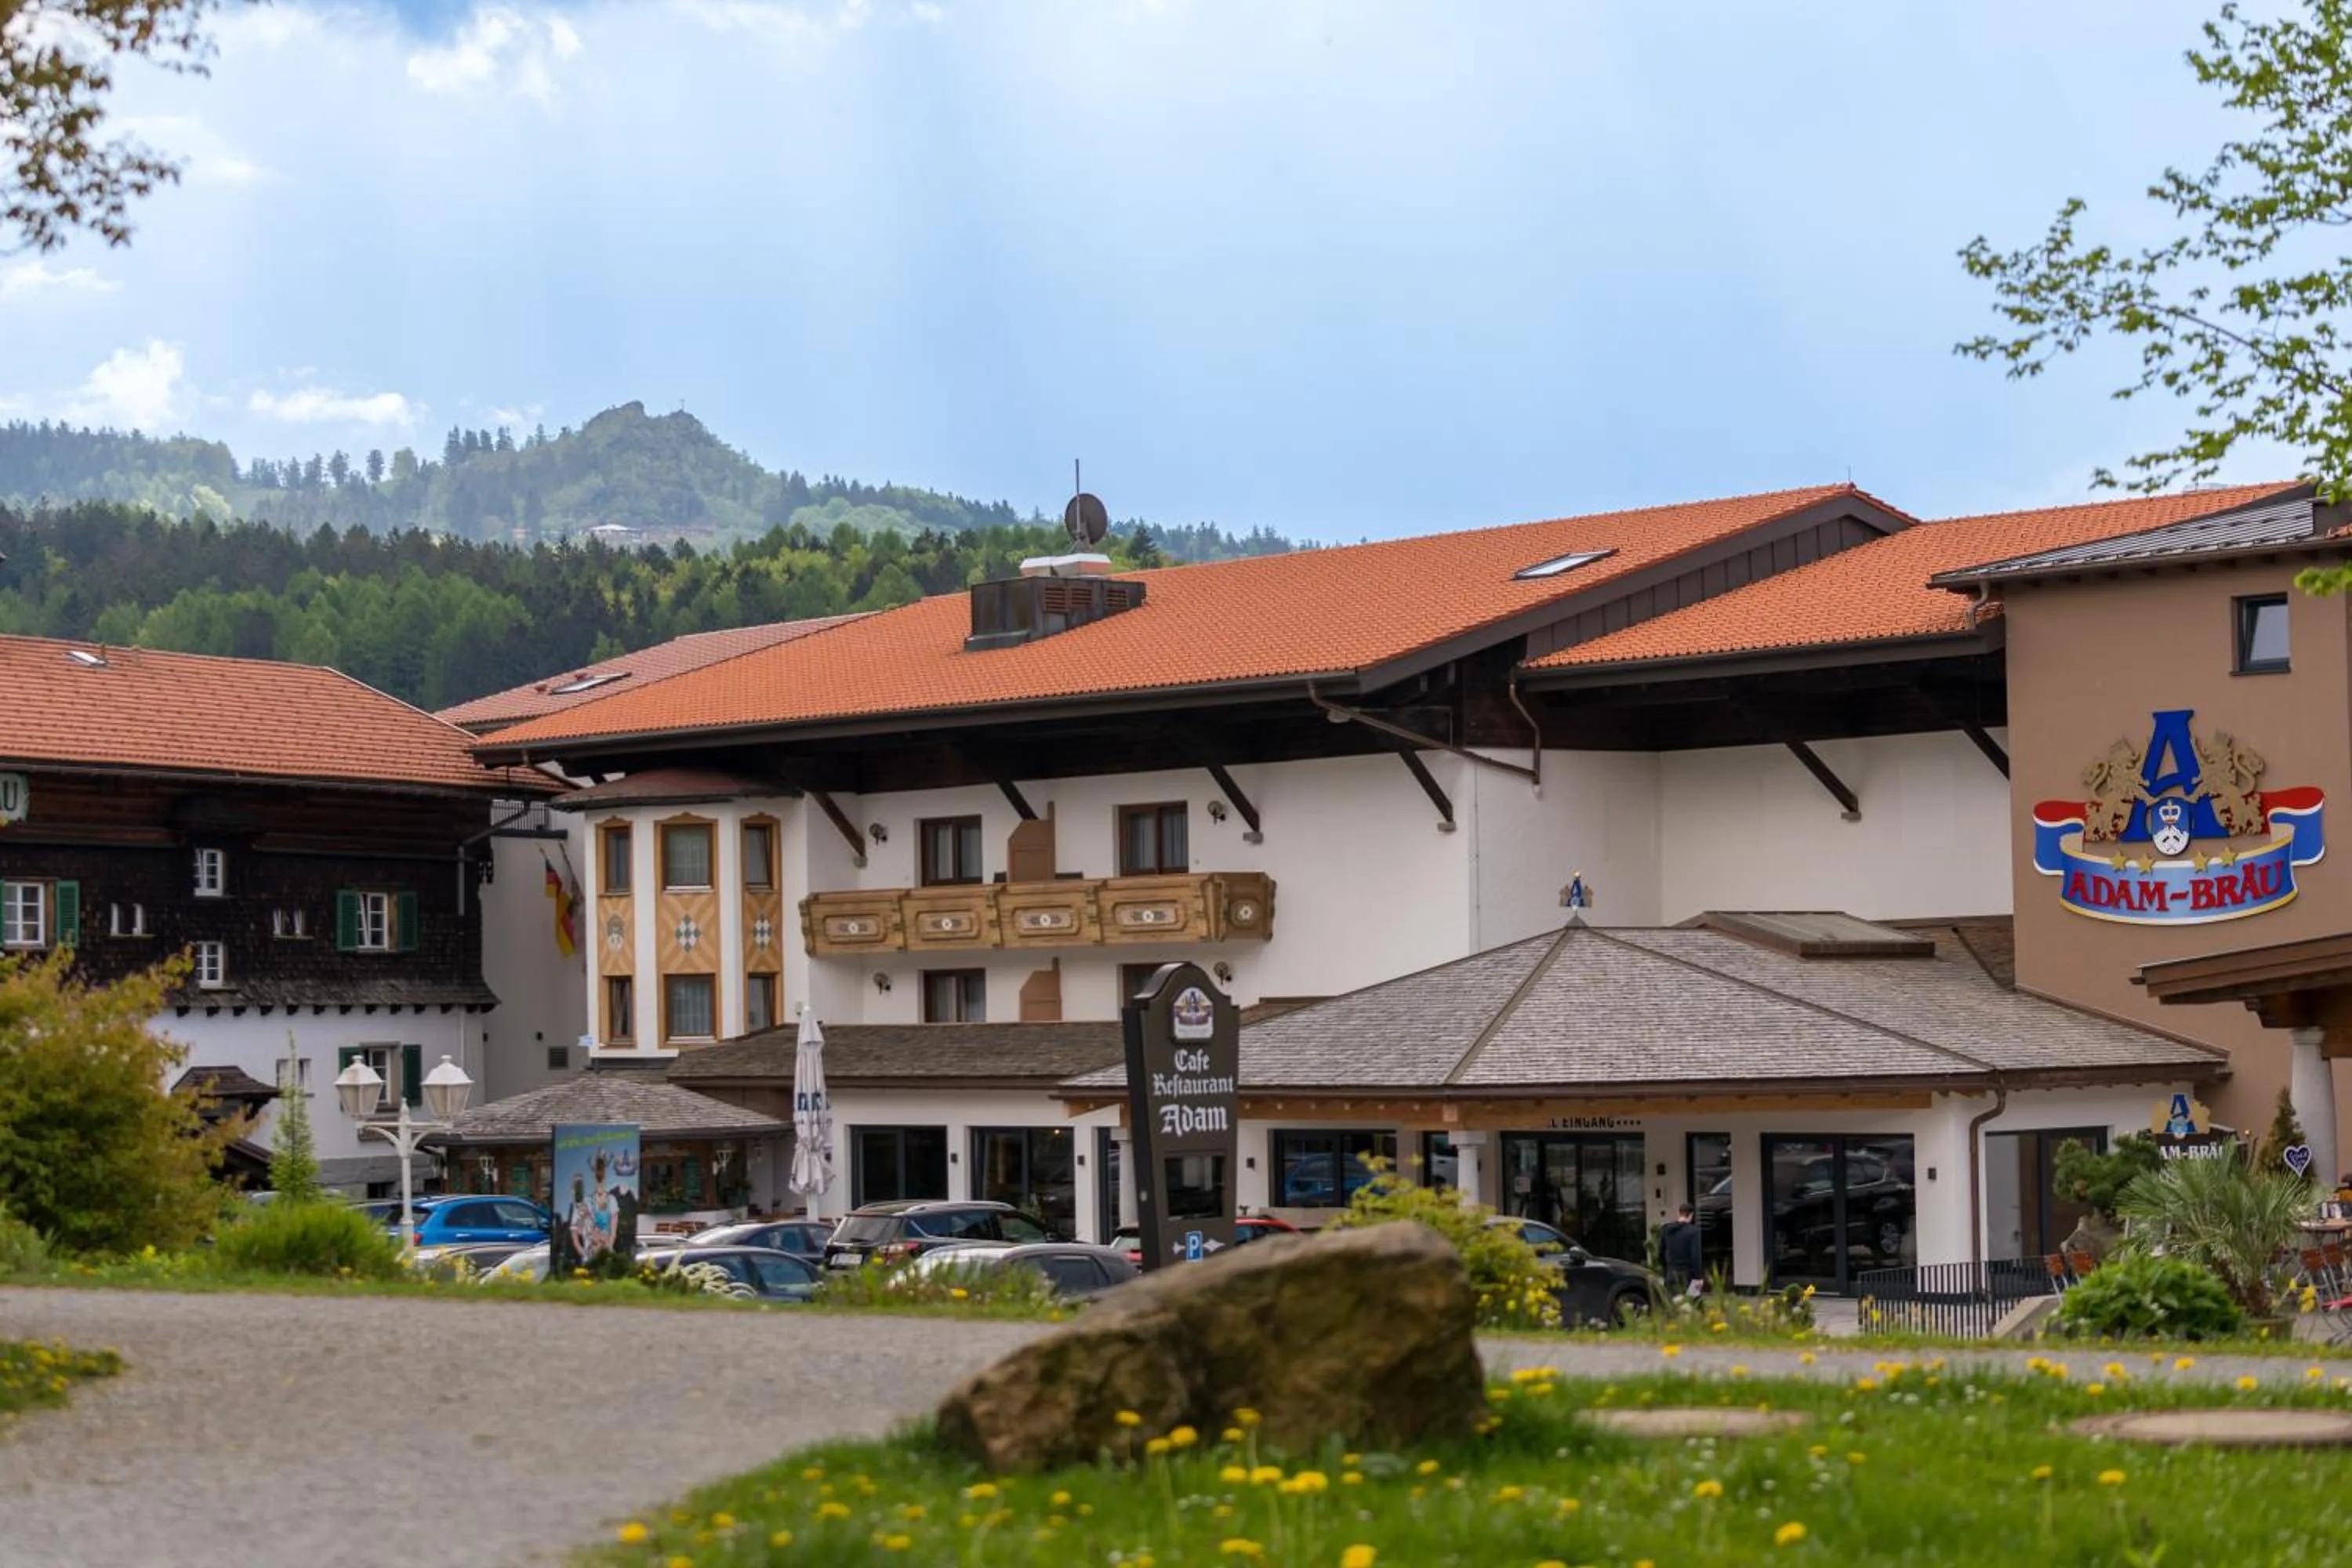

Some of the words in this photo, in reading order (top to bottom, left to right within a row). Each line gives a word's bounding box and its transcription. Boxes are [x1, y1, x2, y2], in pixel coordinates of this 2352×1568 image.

[2119, 709, 2230, 842] A
[0, 780, 18, 811] U
[2067, 861, 2284, 912] ADAM-BRÄU
[1175, 1049, 1210, 1074] Cafe
[1152, 1073, 1234, 1098] Restaurant
[1160, 1103, 1229, 1137] Adam
[2159, 1142, 2223, 1160] AM-BRÄ
[1189, 1235, 1200, 1258] P
